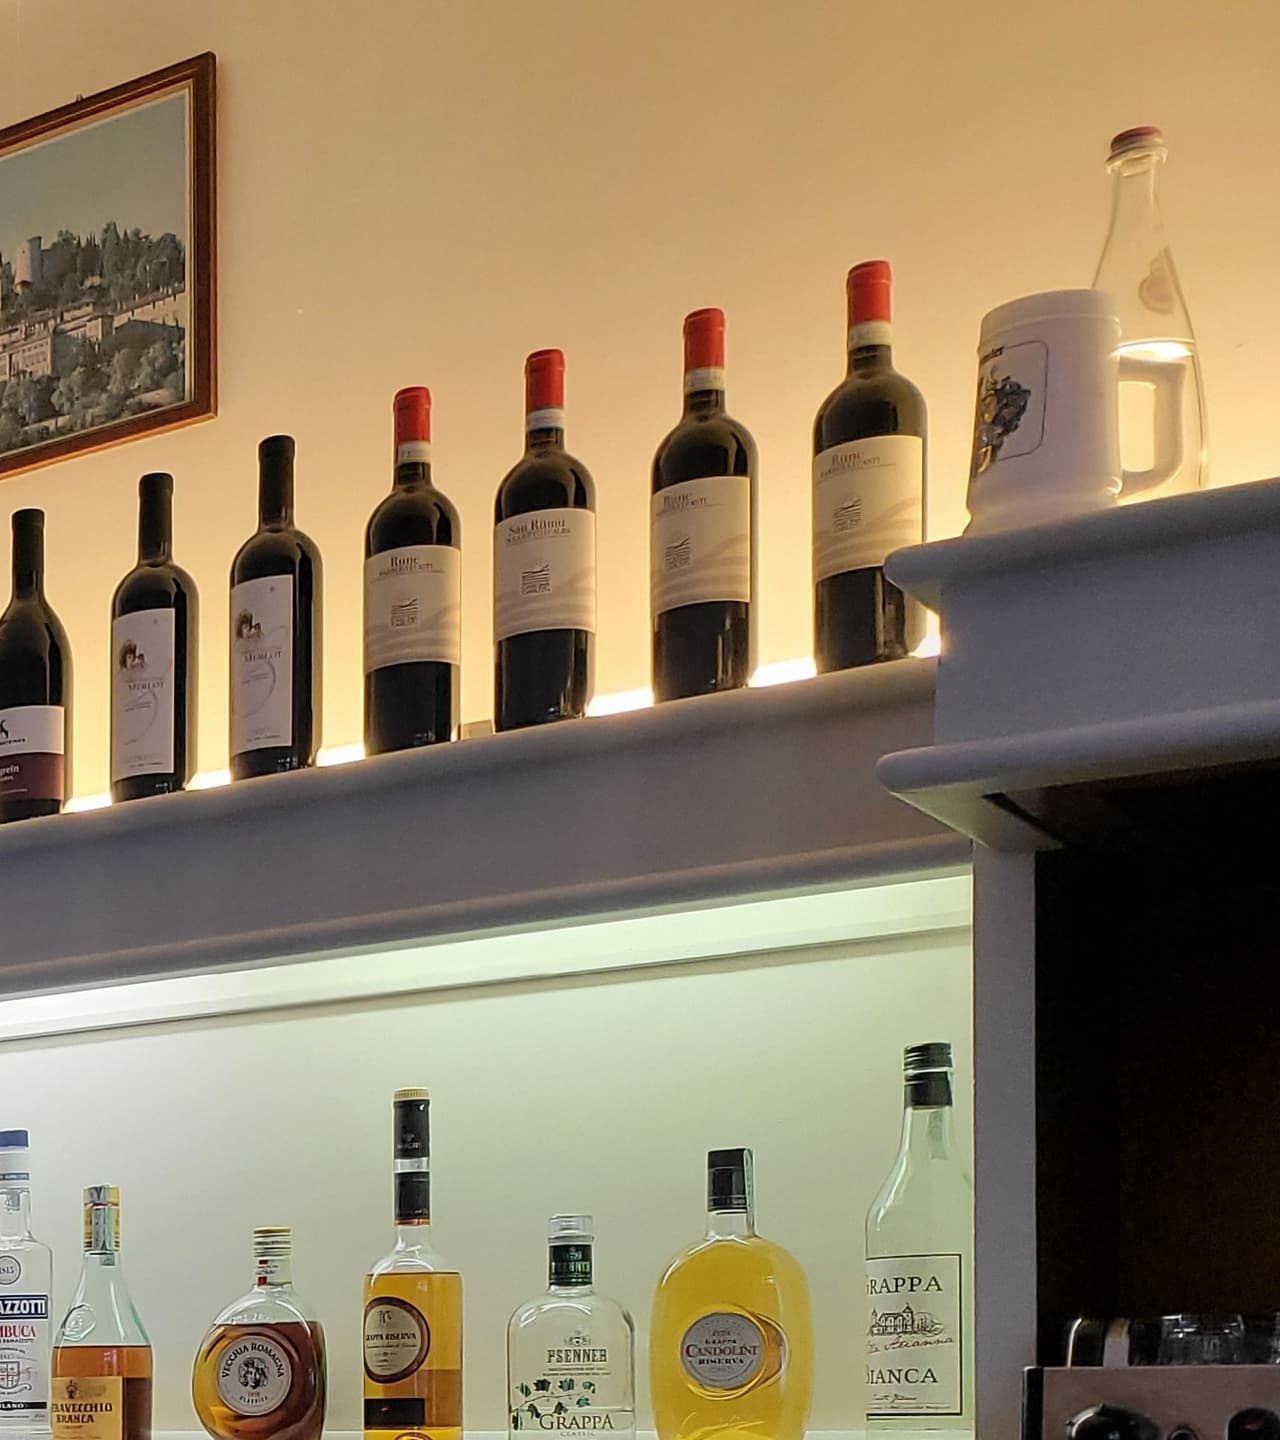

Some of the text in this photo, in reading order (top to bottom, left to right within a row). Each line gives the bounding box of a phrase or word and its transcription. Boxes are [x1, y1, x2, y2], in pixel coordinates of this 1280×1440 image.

[221, 1342, 285, 1378] VECCHIA ROMAGNA
[698, 1358, 745, 1366] RISERVA
[56, 1413, 95, 1424] BRANCA
[539, 1413, 615, 1431] GRAPPA
